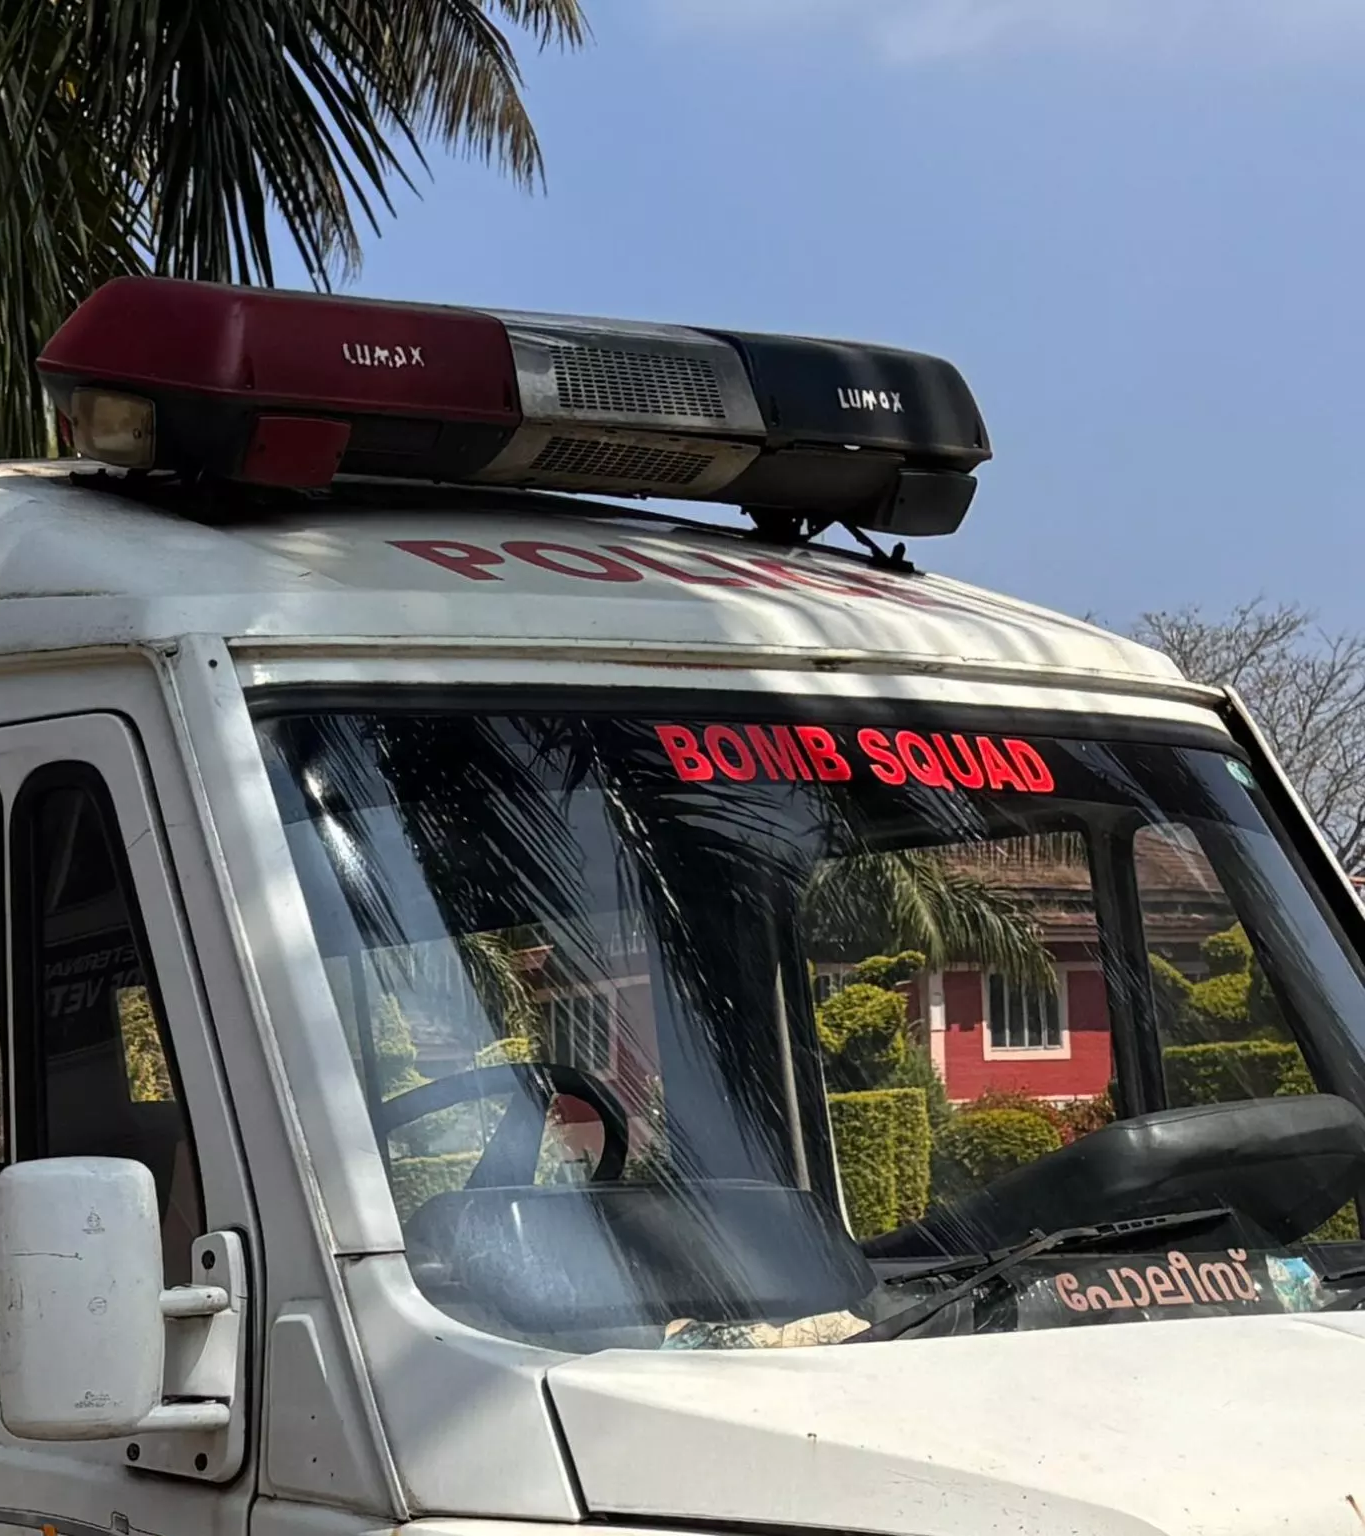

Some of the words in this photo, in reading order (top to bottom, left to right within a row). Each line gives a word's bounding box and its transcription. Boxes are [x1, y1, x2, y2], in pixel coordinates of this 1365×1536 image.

[654, 724, 852, 782] BOMB
[856, 727, 1056, 793] SQUAD
[1056, 1249, 1257, 1312] പോലീസ്
